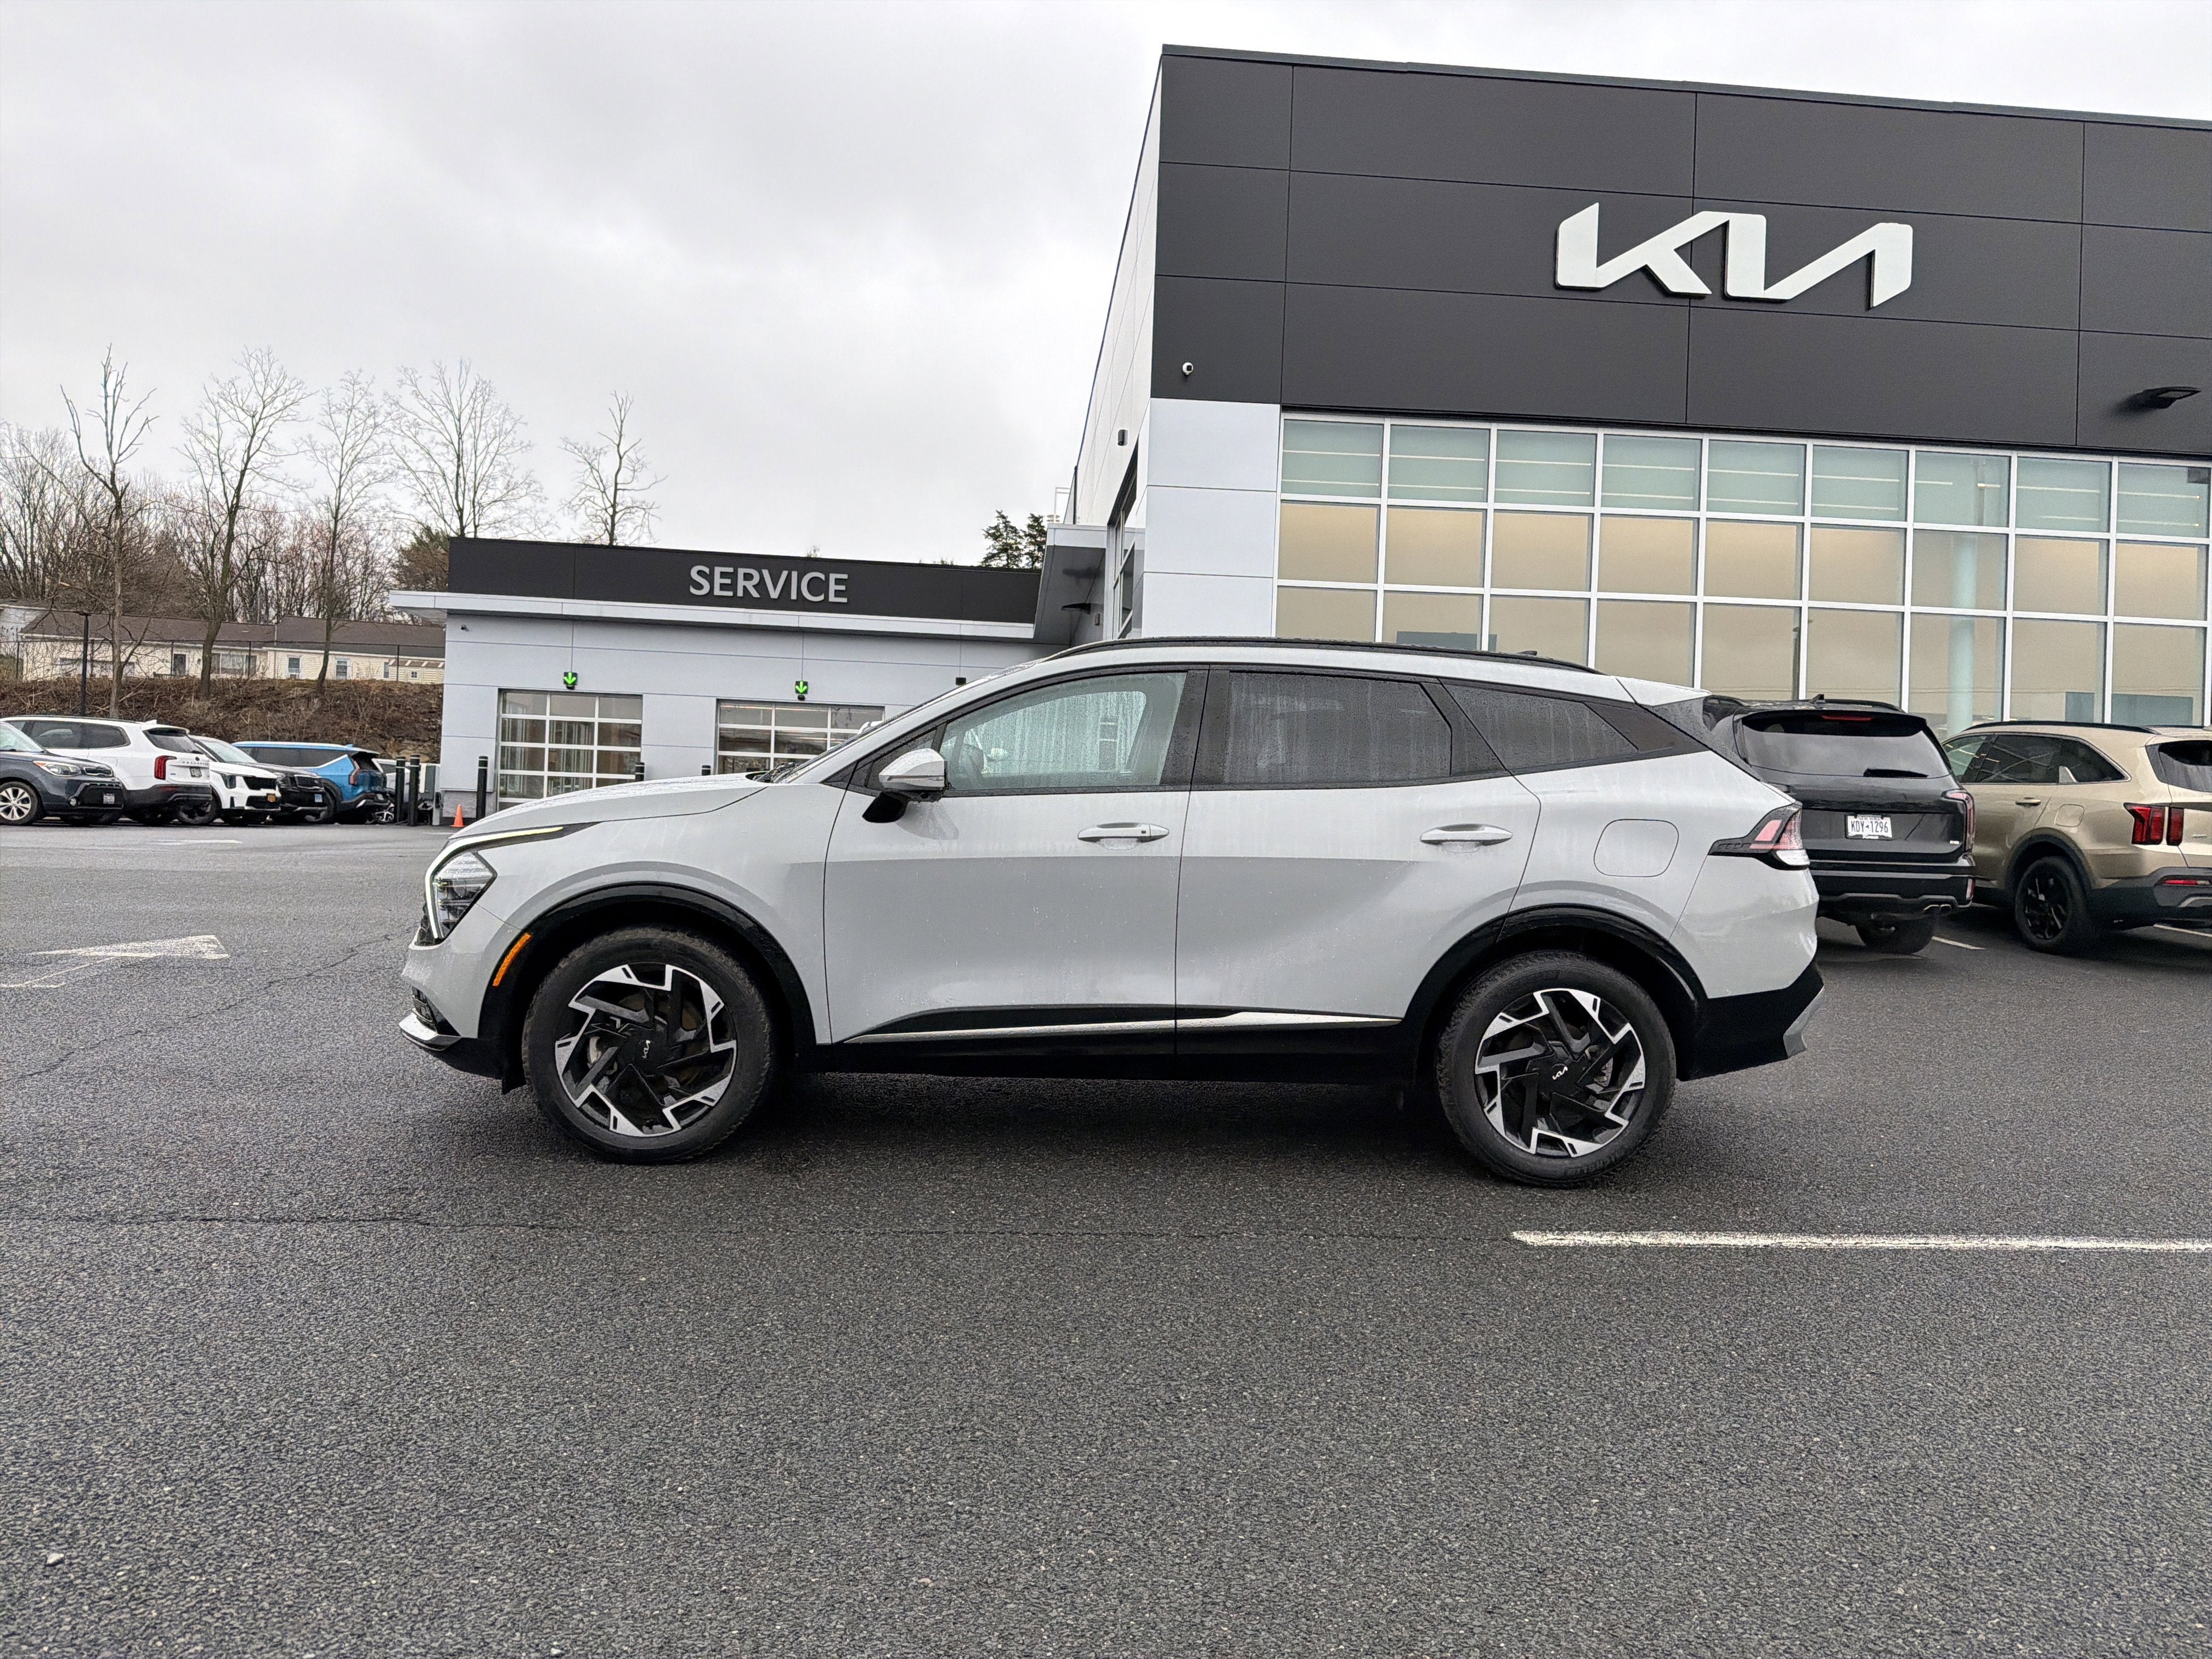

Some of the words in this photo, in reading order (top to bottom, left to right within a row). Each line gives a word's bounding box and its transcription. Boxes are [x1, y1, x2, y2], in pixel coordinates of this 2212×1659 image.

[1556, 202, 1914, 309] KIA
[690, 565, 849, 603] SERVICE
[1851, 820, 1864, 833] KDY
[1870, 821, 1889, 833] 1296
